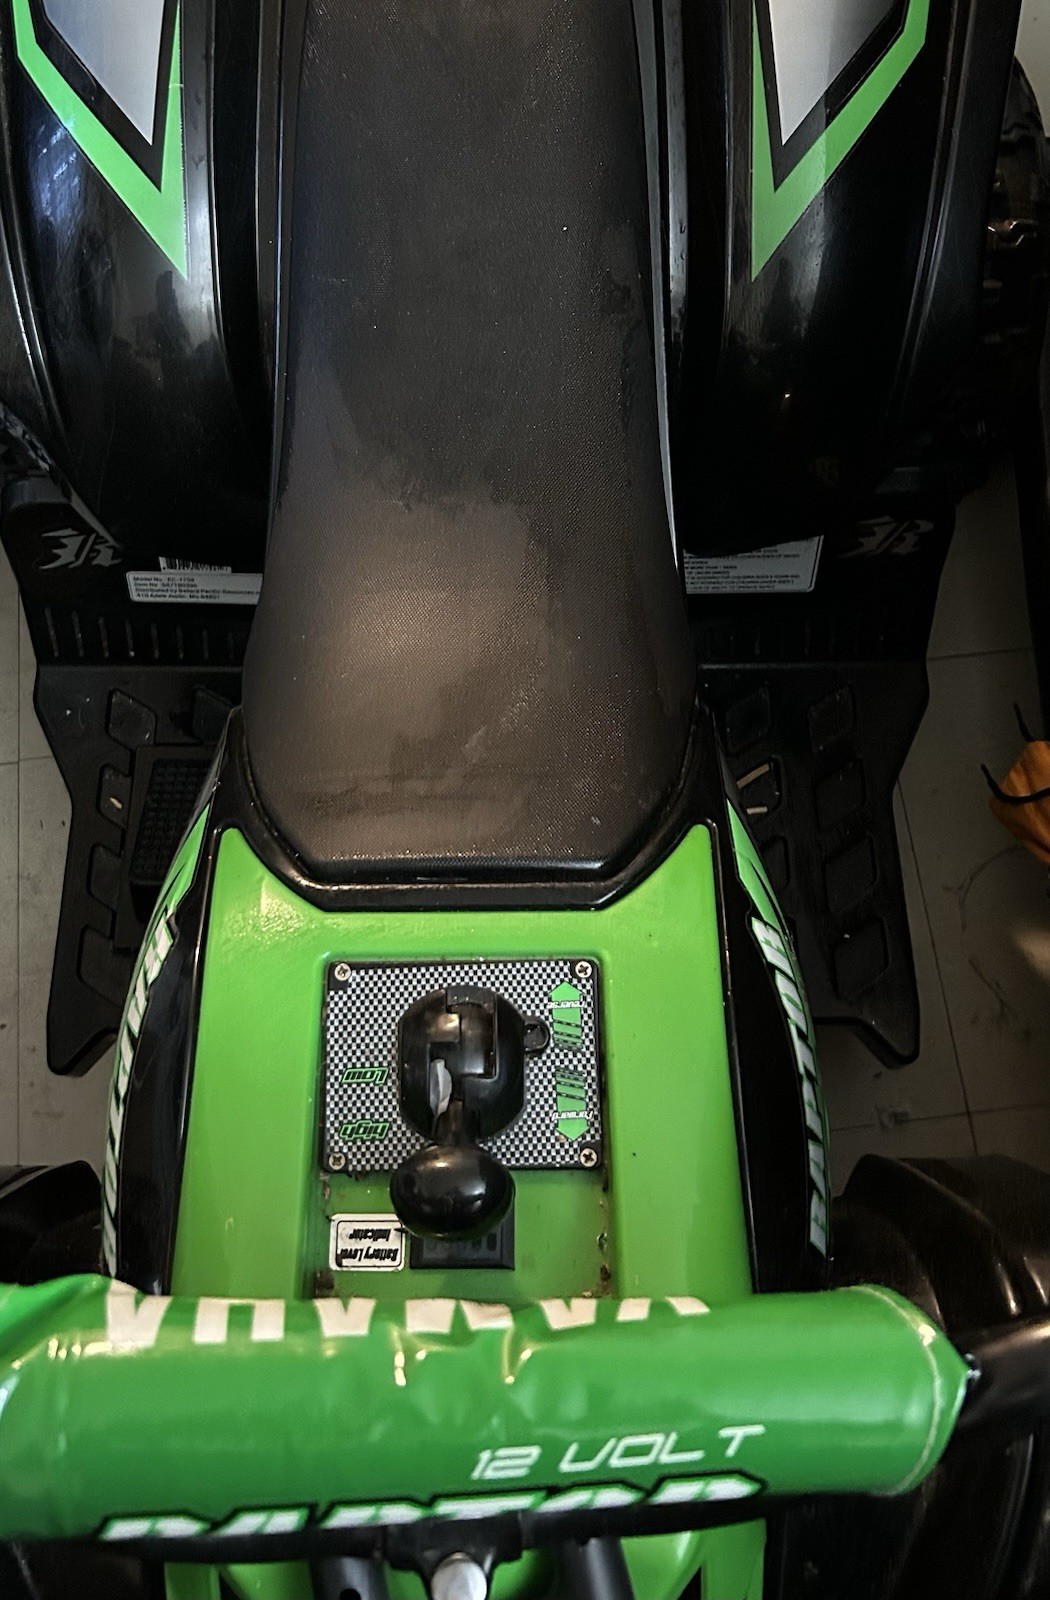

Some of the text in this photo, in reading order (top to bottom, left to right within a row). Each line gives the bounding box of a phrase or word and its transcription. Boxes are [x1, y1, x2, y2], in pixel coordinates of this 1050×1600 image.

[751, 916, 831, 1258] RAPTOR
[349, 1228, 391, 1242] Indicator
[364, 1246, 399, 1262] Battery
[470, 1445, 542, 1481] 12
